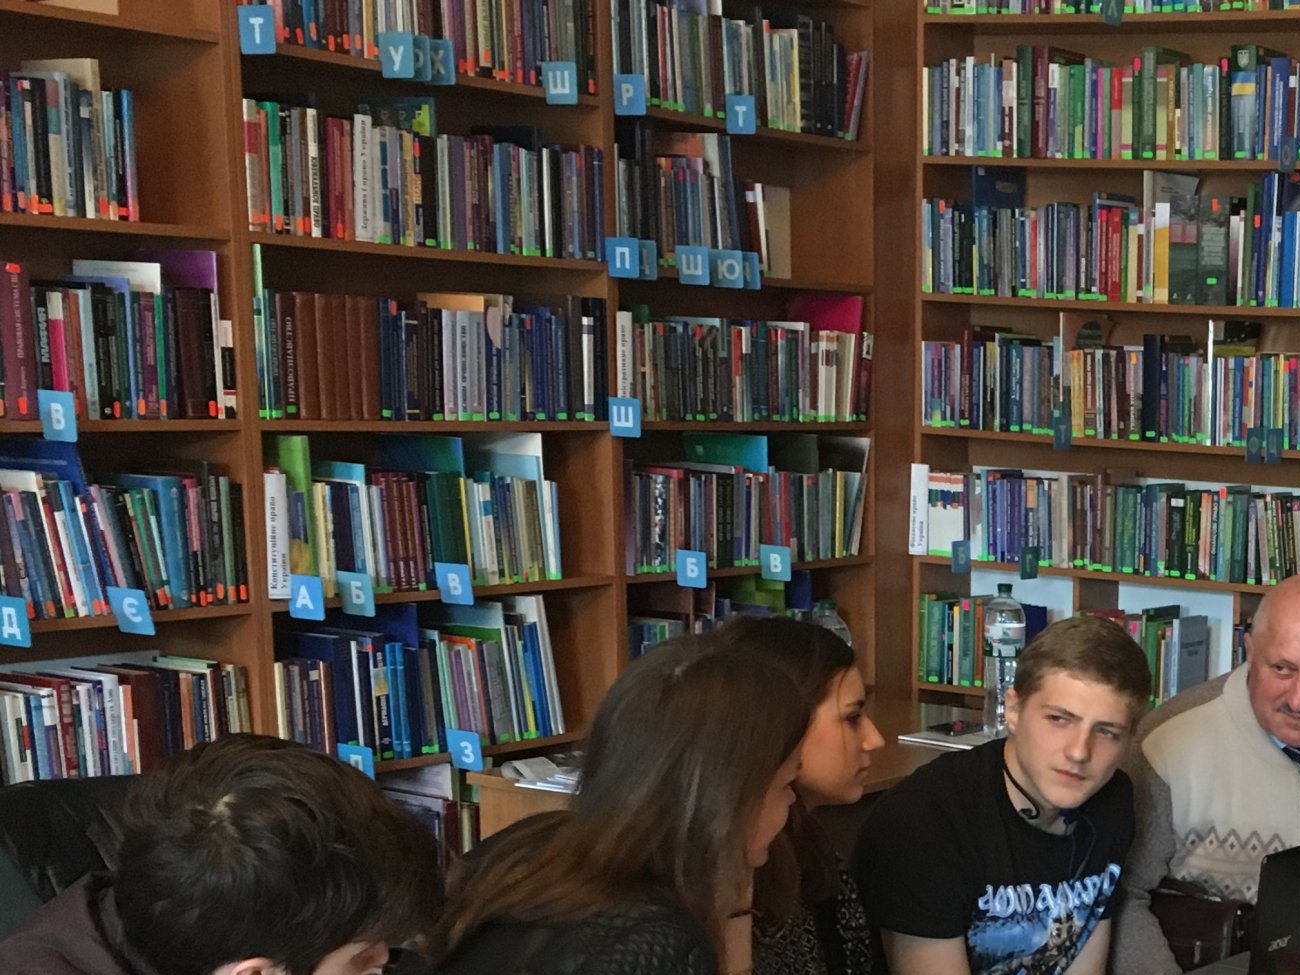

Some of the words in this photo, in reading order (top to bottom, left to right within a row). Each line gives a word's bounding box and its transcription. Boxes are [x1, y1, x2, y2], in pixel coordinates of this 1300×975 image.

[250, 18, 263, 44] Т
[389, 46, 404, 71] У
[549, 71, 570, 94] Ш
[621, 83, 634, 106] Р
[734, 105, 747, 127] Т
[615, 246, 630, 269] П
[682, 254, 702, 275] Ш
[718, 259, 740, 280] Ю
[37, 306, 50, 363] МАФИЯ
[285, 316, 296, 402] ПРАВОЗНАВСТВО
[51, 402, 65, 430] В
[613, 406, 634, 428] Ш
[686, 558, 698, 578] Б
[770, 553, 782, 573] В
[350, 581, 365, 604] Б
[447, 573, 462, 596] В
[296, 585, 314, 610] А
[122, 597, 142, 624] Є
[2, 607, 21, 640] Д
[460, 741, 475, 764] З
[1268, 936, 1292, 951] acer
